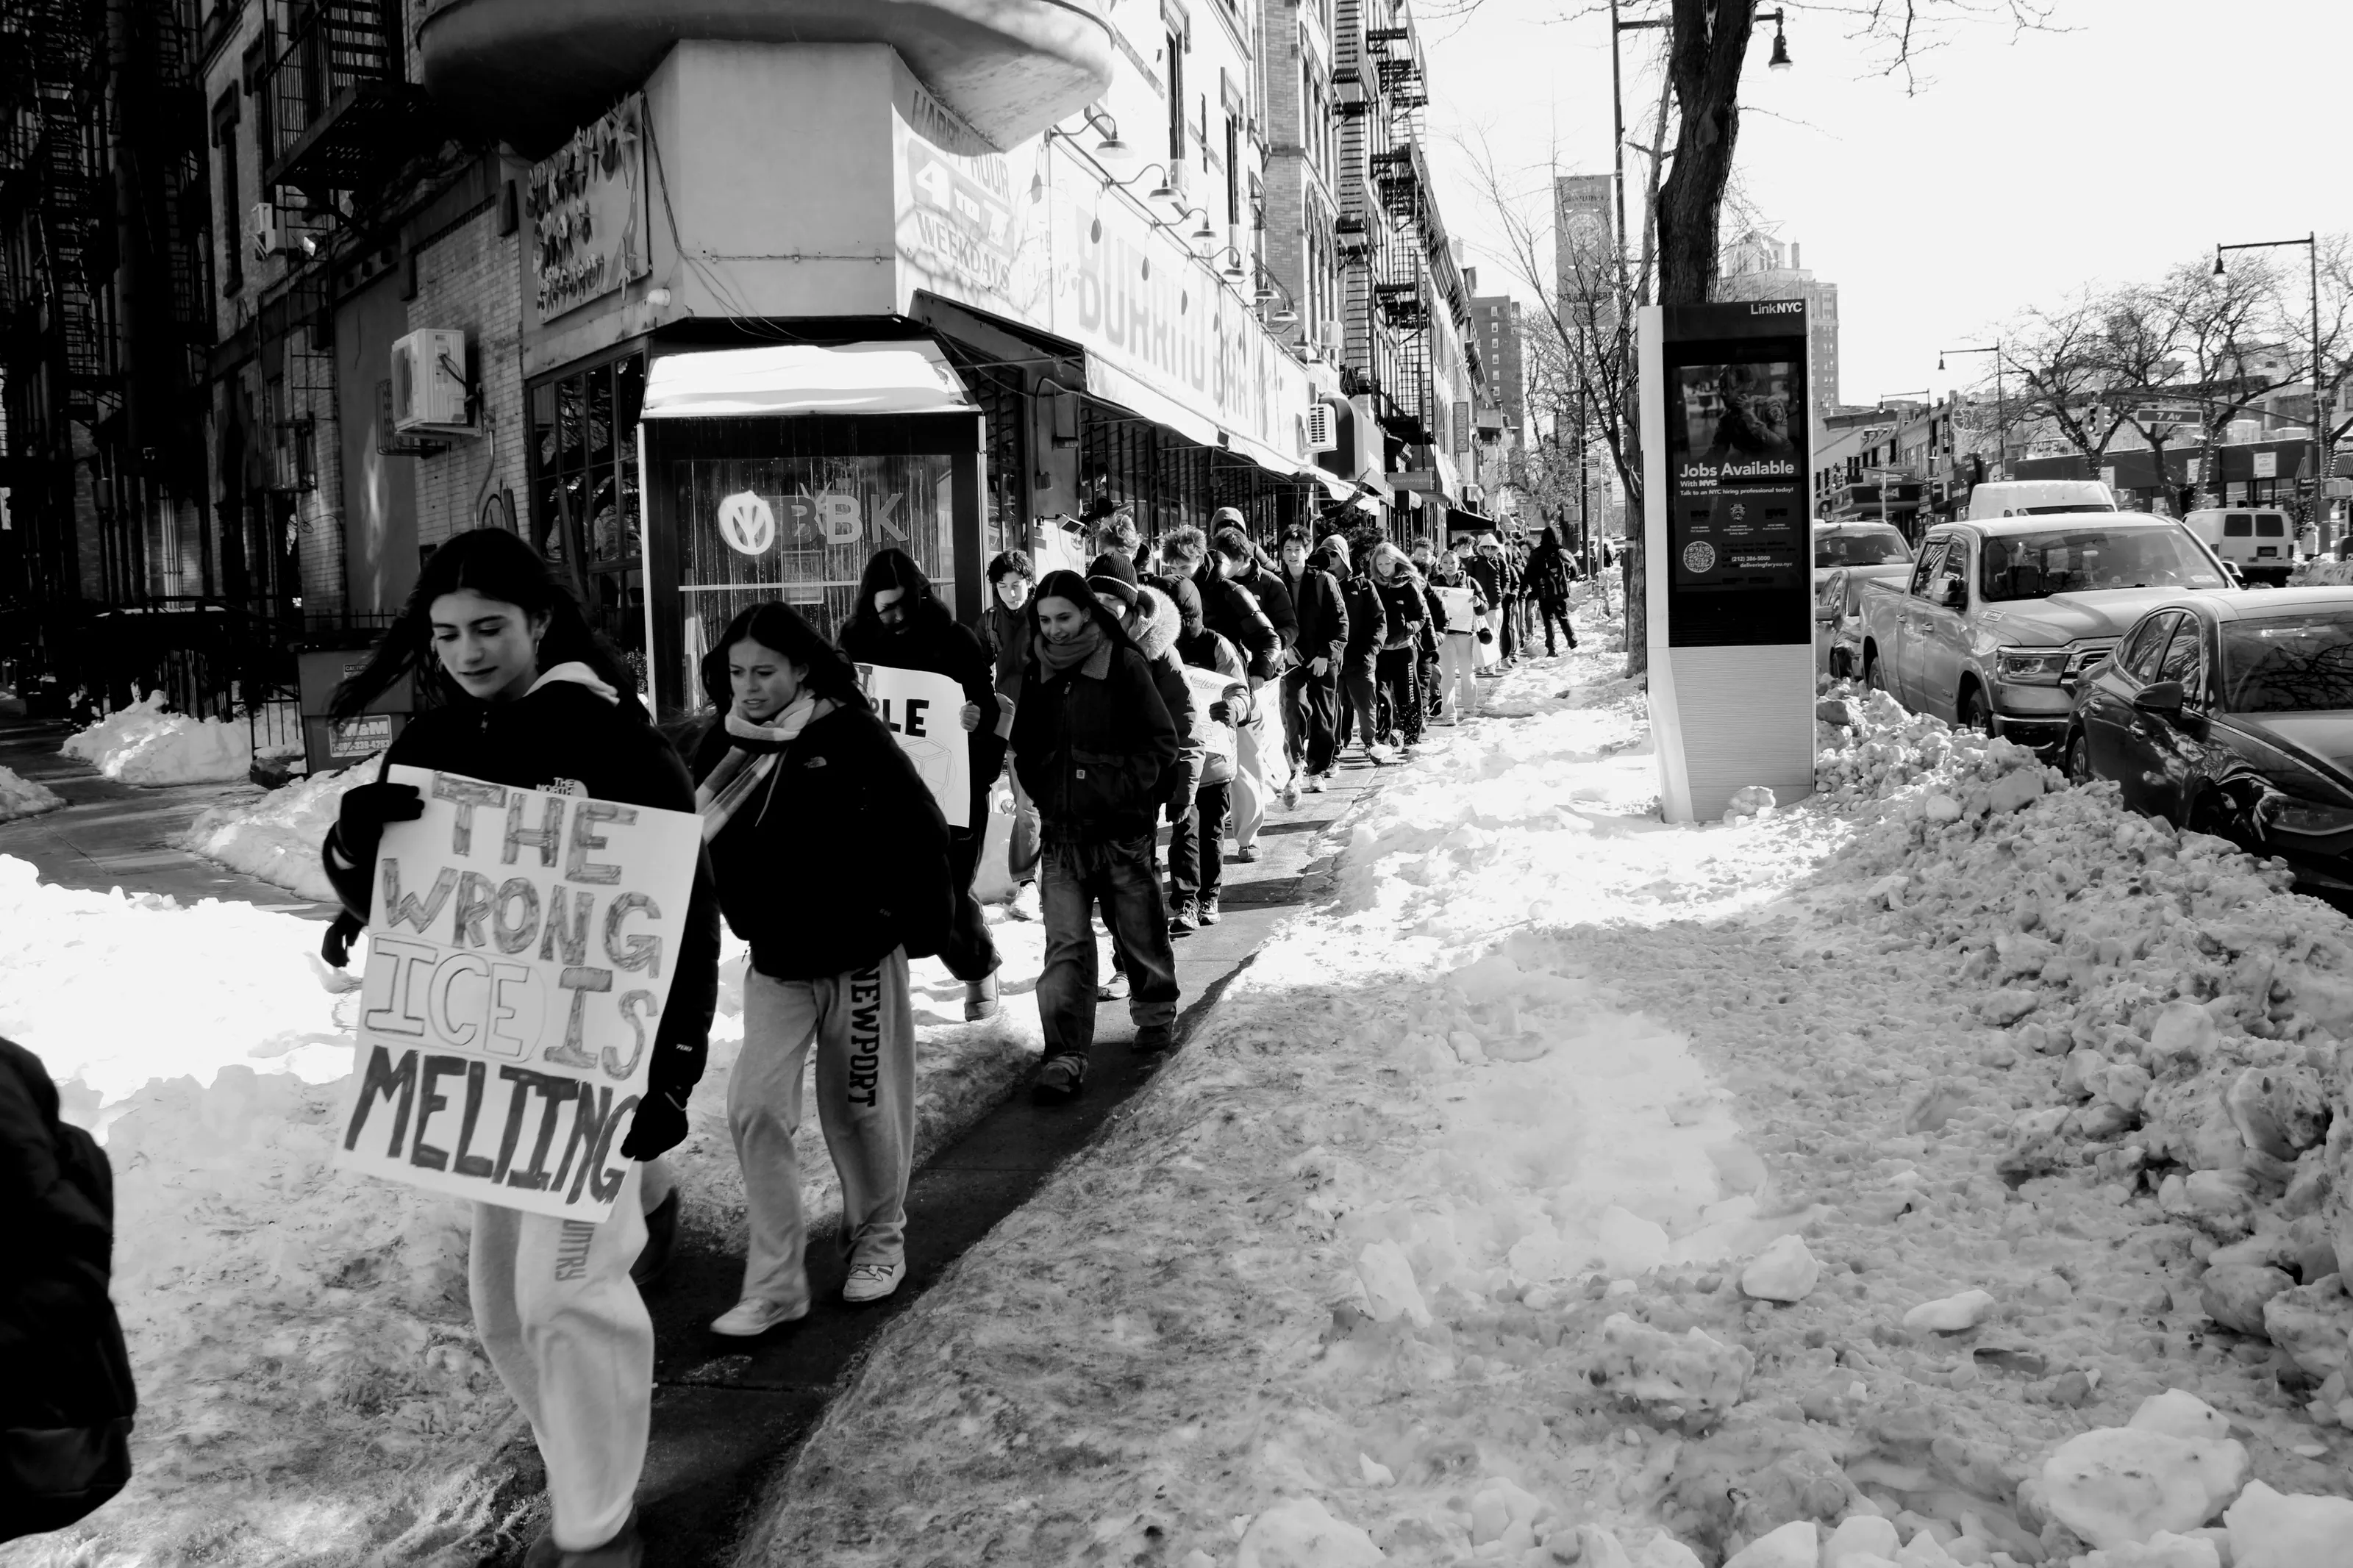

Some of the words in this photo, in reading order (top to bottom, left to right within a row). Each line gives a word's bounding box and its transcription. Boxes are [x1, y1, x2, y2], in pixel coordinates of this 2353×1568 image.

[915, 160, 949, 212] 4
[954, 188, 979, 223] TO
[983, 199, 1010, 248] 7
[916, 211, 1012, 292] WEEKDAYS
[1076, 204, 1204, 394] BURRITO
[1751, 301, 1803, 315] LinkNYC
[2156, 412, 2164, 420] 7
[2167, 412, 2182, 420] Av
[1680, 463, 1717, 478] Jobs
[1721, 459, 1794, 476] Available
[1740, 487, 1774, 495] professional
[553, 777, 574, 788] THE
[432, 770, 638, 884] THE
[381, 857, 663, 978] WRONG
[365, 937, 530, 1057] ICE
[544, 966, 660, 1081] IS
[847, 962, 881, 1107] NEWPORT
[343, 1045, 642, 1206] MELTING
